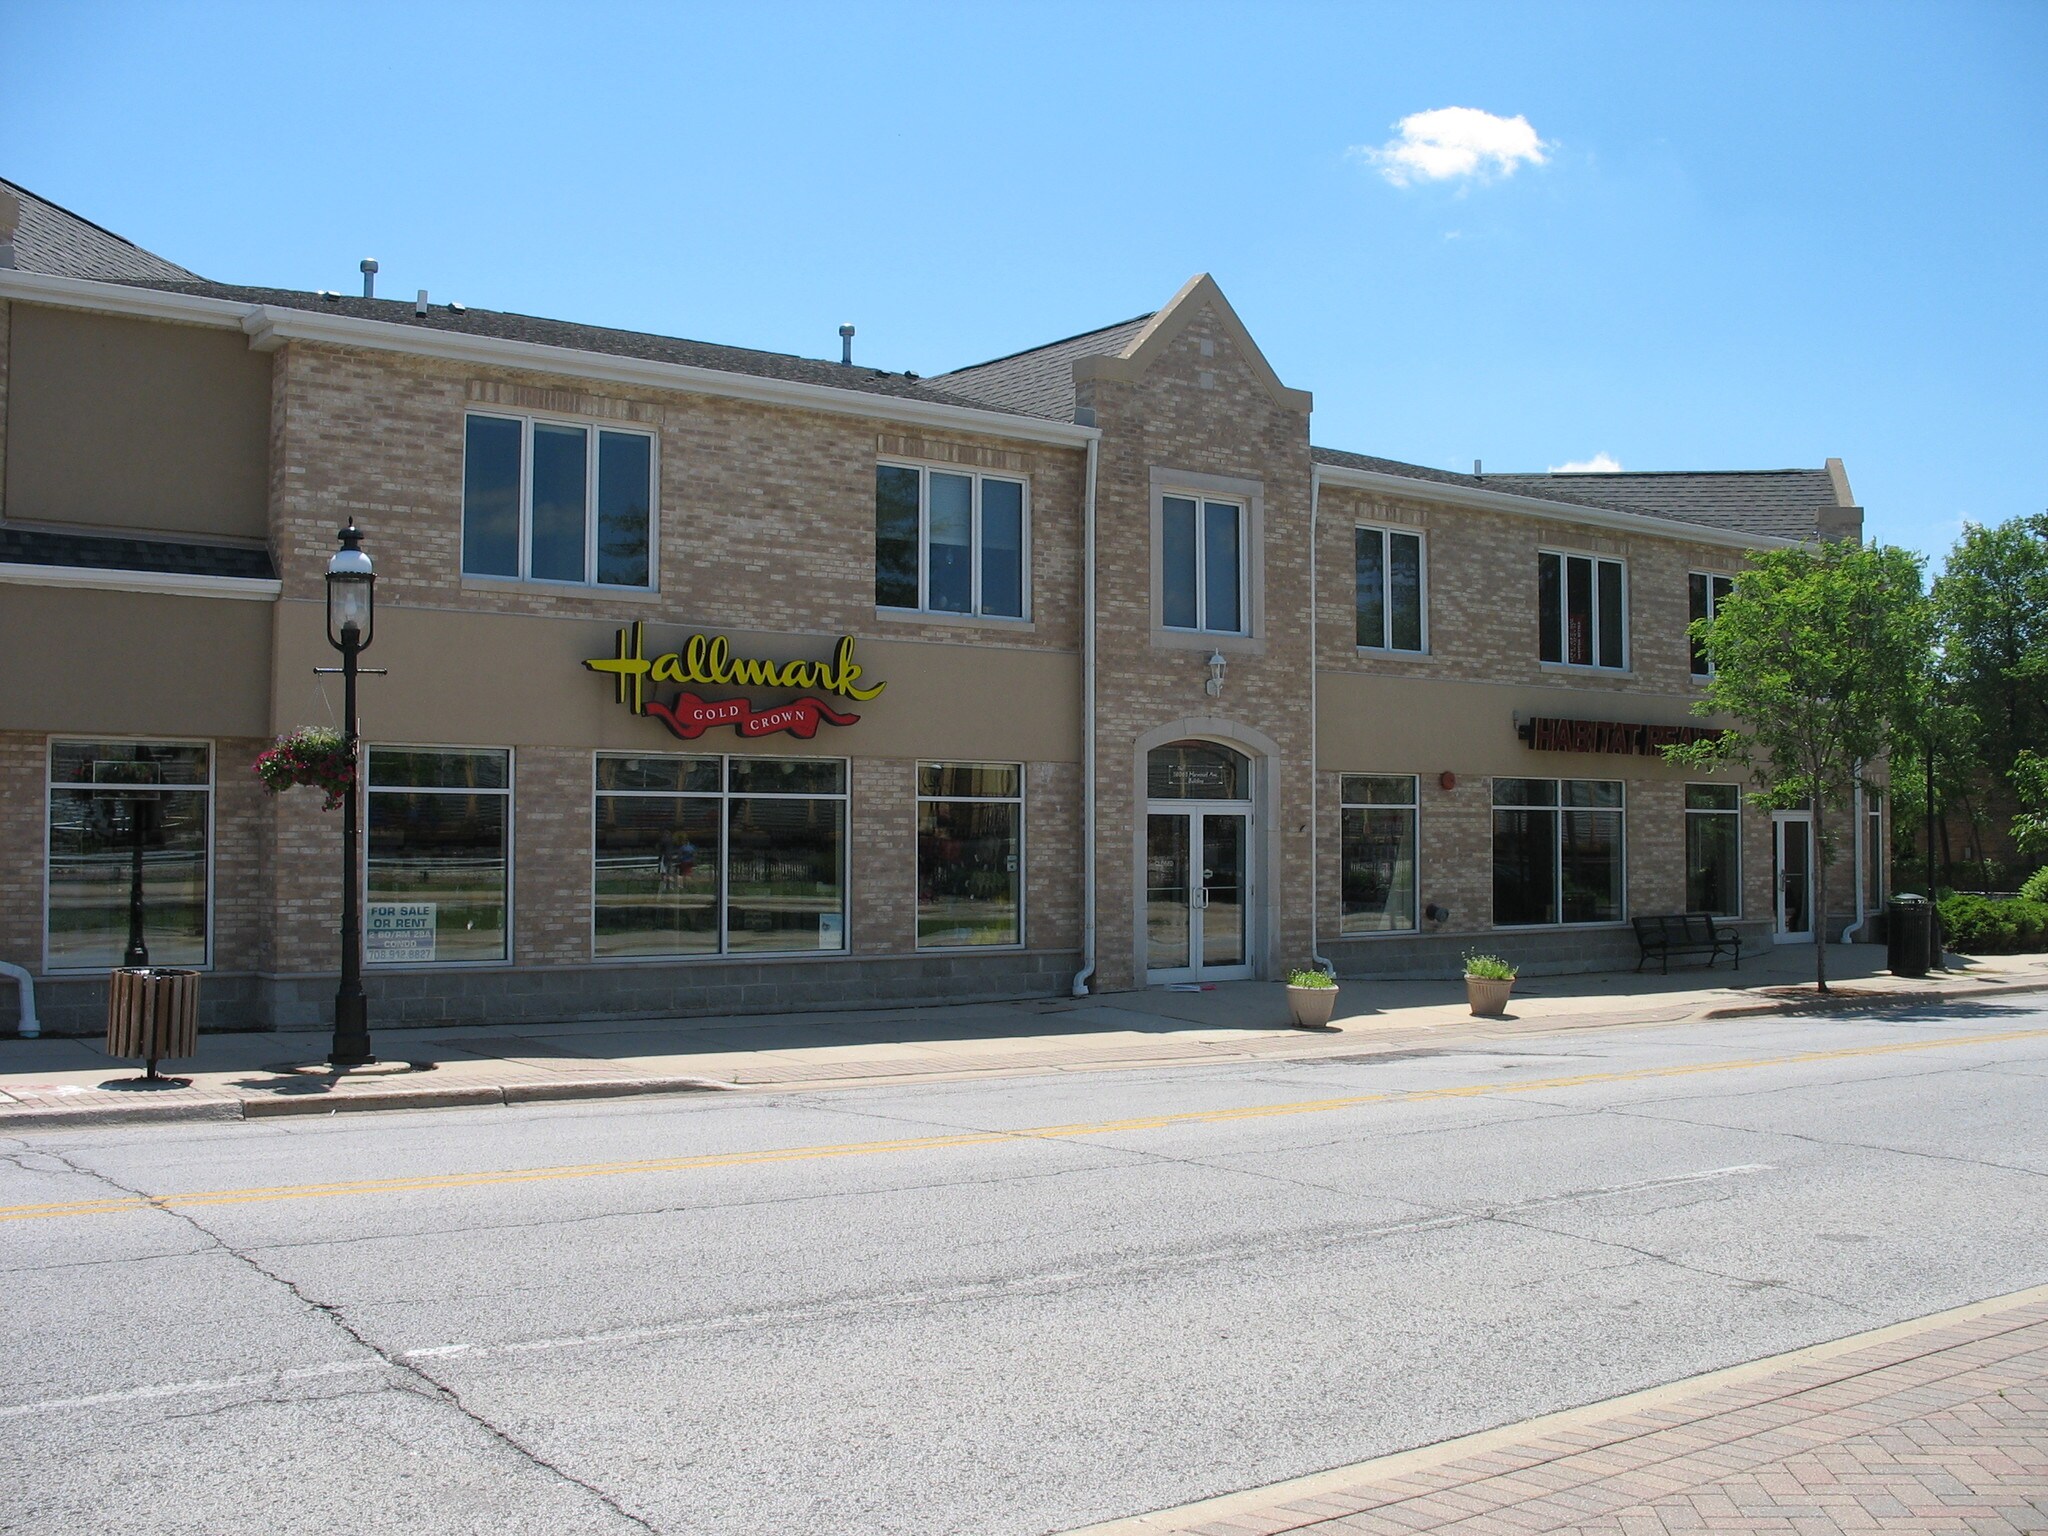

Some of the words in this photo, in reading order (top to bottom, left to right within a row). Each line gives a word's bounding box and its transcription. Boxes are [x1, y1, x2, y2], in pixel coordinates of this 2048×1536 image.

[582, 620, 888, 714] Hallmark
[693, 705, 739, 720] GOLD
[749, 709, 806, 731] CROWN
[1534, 717, 1641, 755] HABITAT
[1645, 723, 1732, 757] REAT
[371, 906, 396, 916] FOR
[400, 906, 430, 916] SALE
[374, 918, 391, 928] OR
[396, 918, 427, 928] RENT
[368, 931, 375, 939] 2
[384, 940, 417, 948] CONDO
